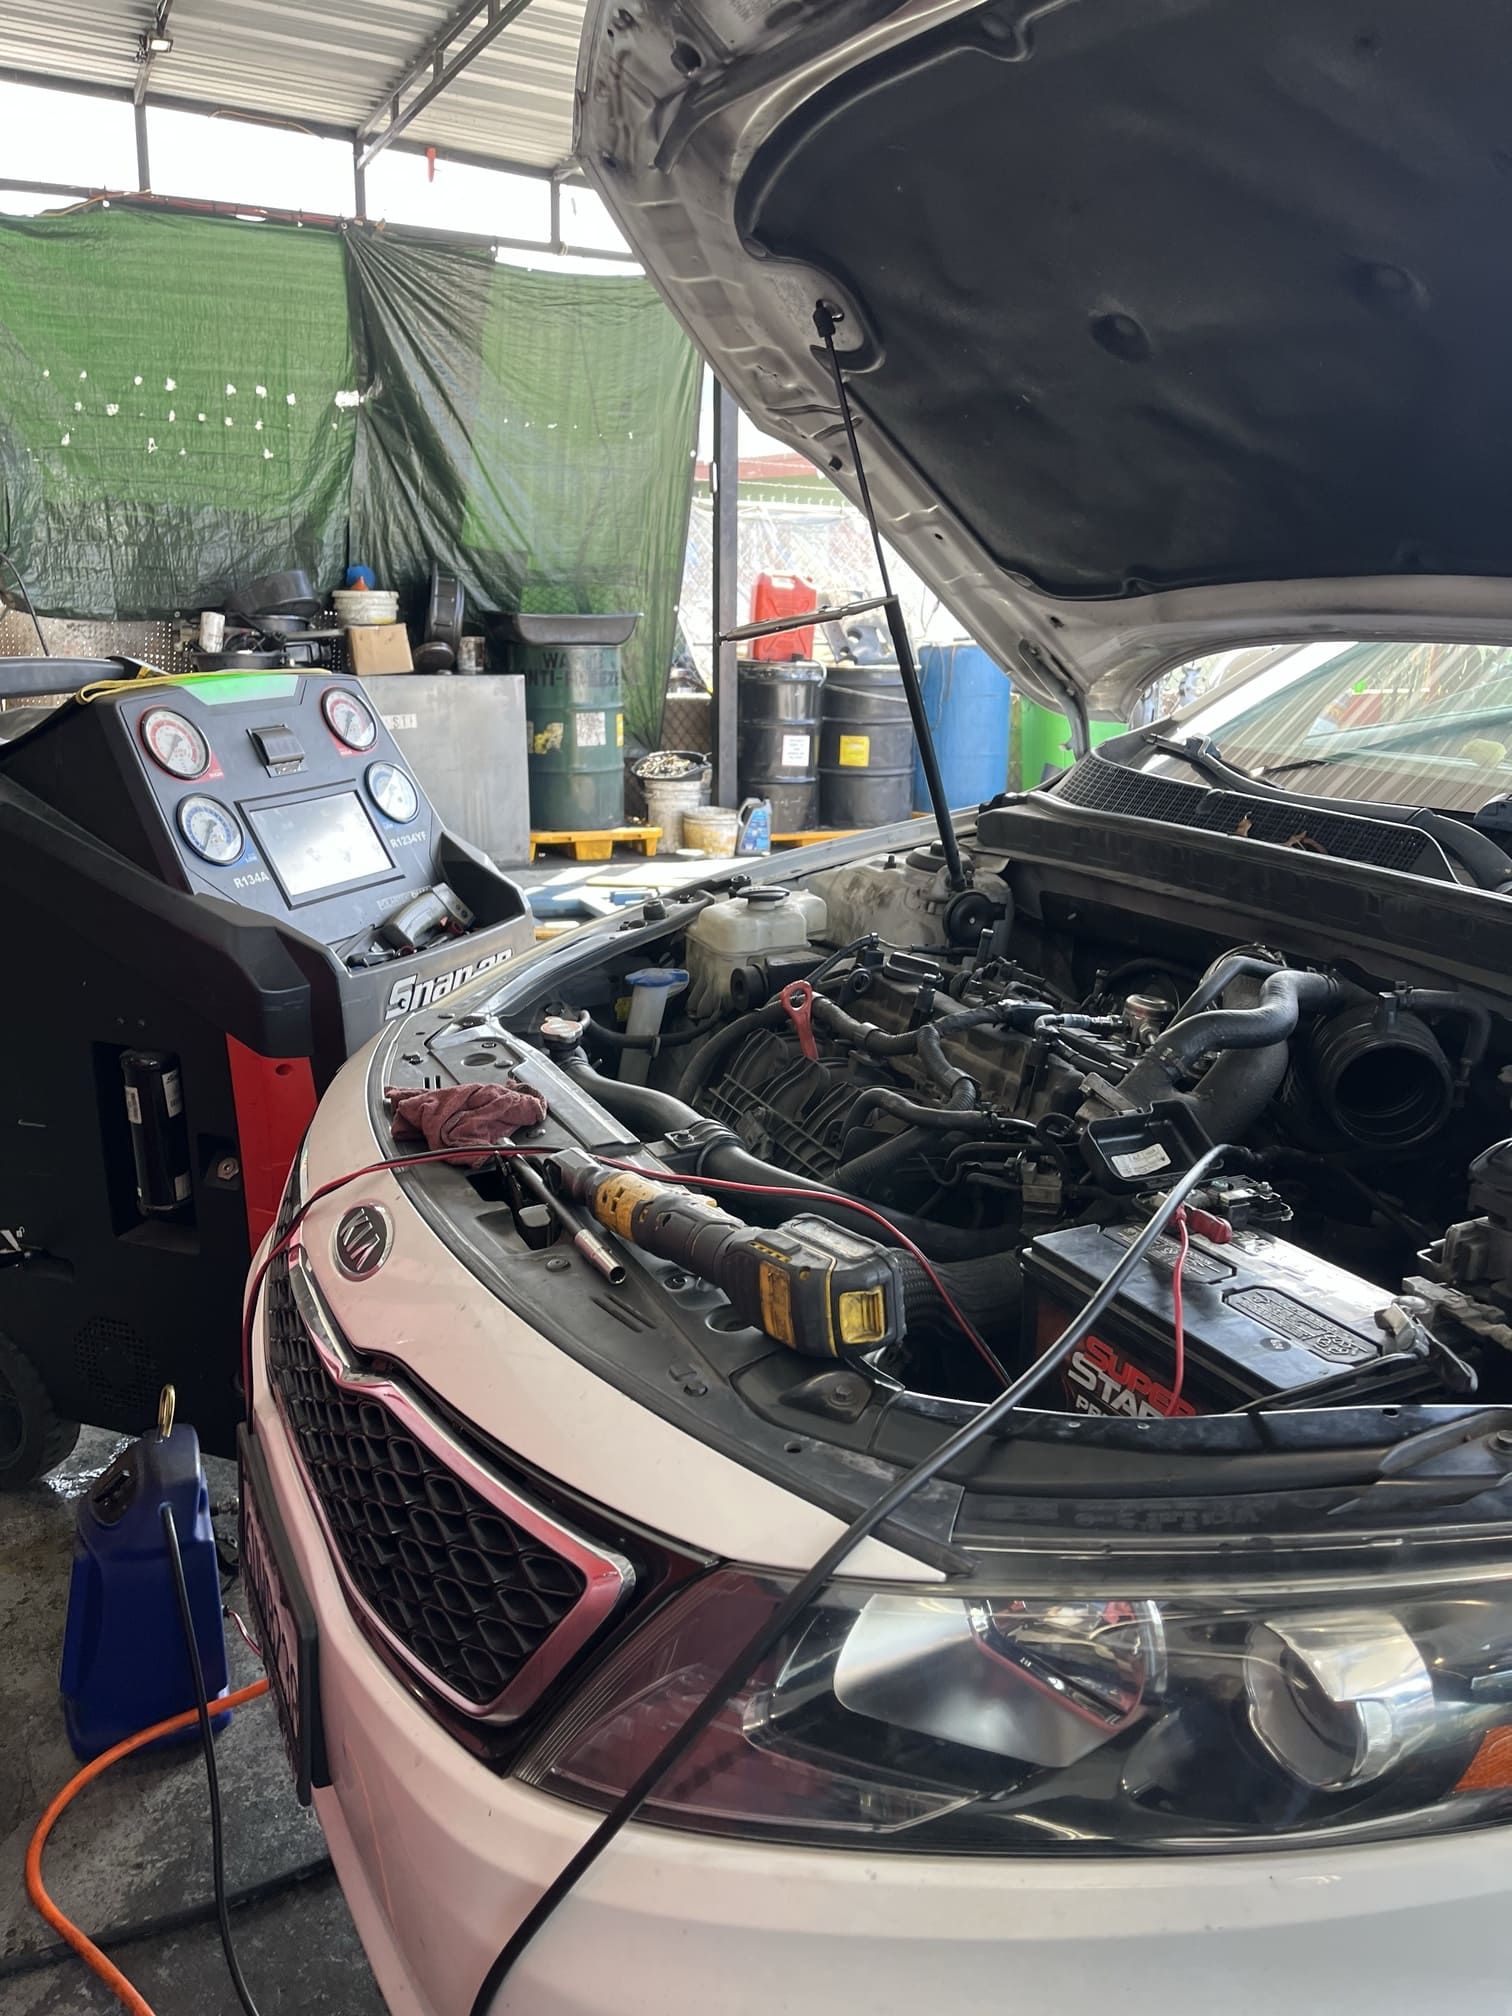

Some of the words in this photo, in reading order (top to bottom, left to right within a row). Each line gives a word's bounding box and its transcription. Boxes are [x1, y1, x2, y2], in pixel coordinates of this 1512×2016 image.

[389, 831, 427, 849] R1234YF
[233, 871, 270, 889] R134A
[1083, 1335, 1197, 1417] SUPER
